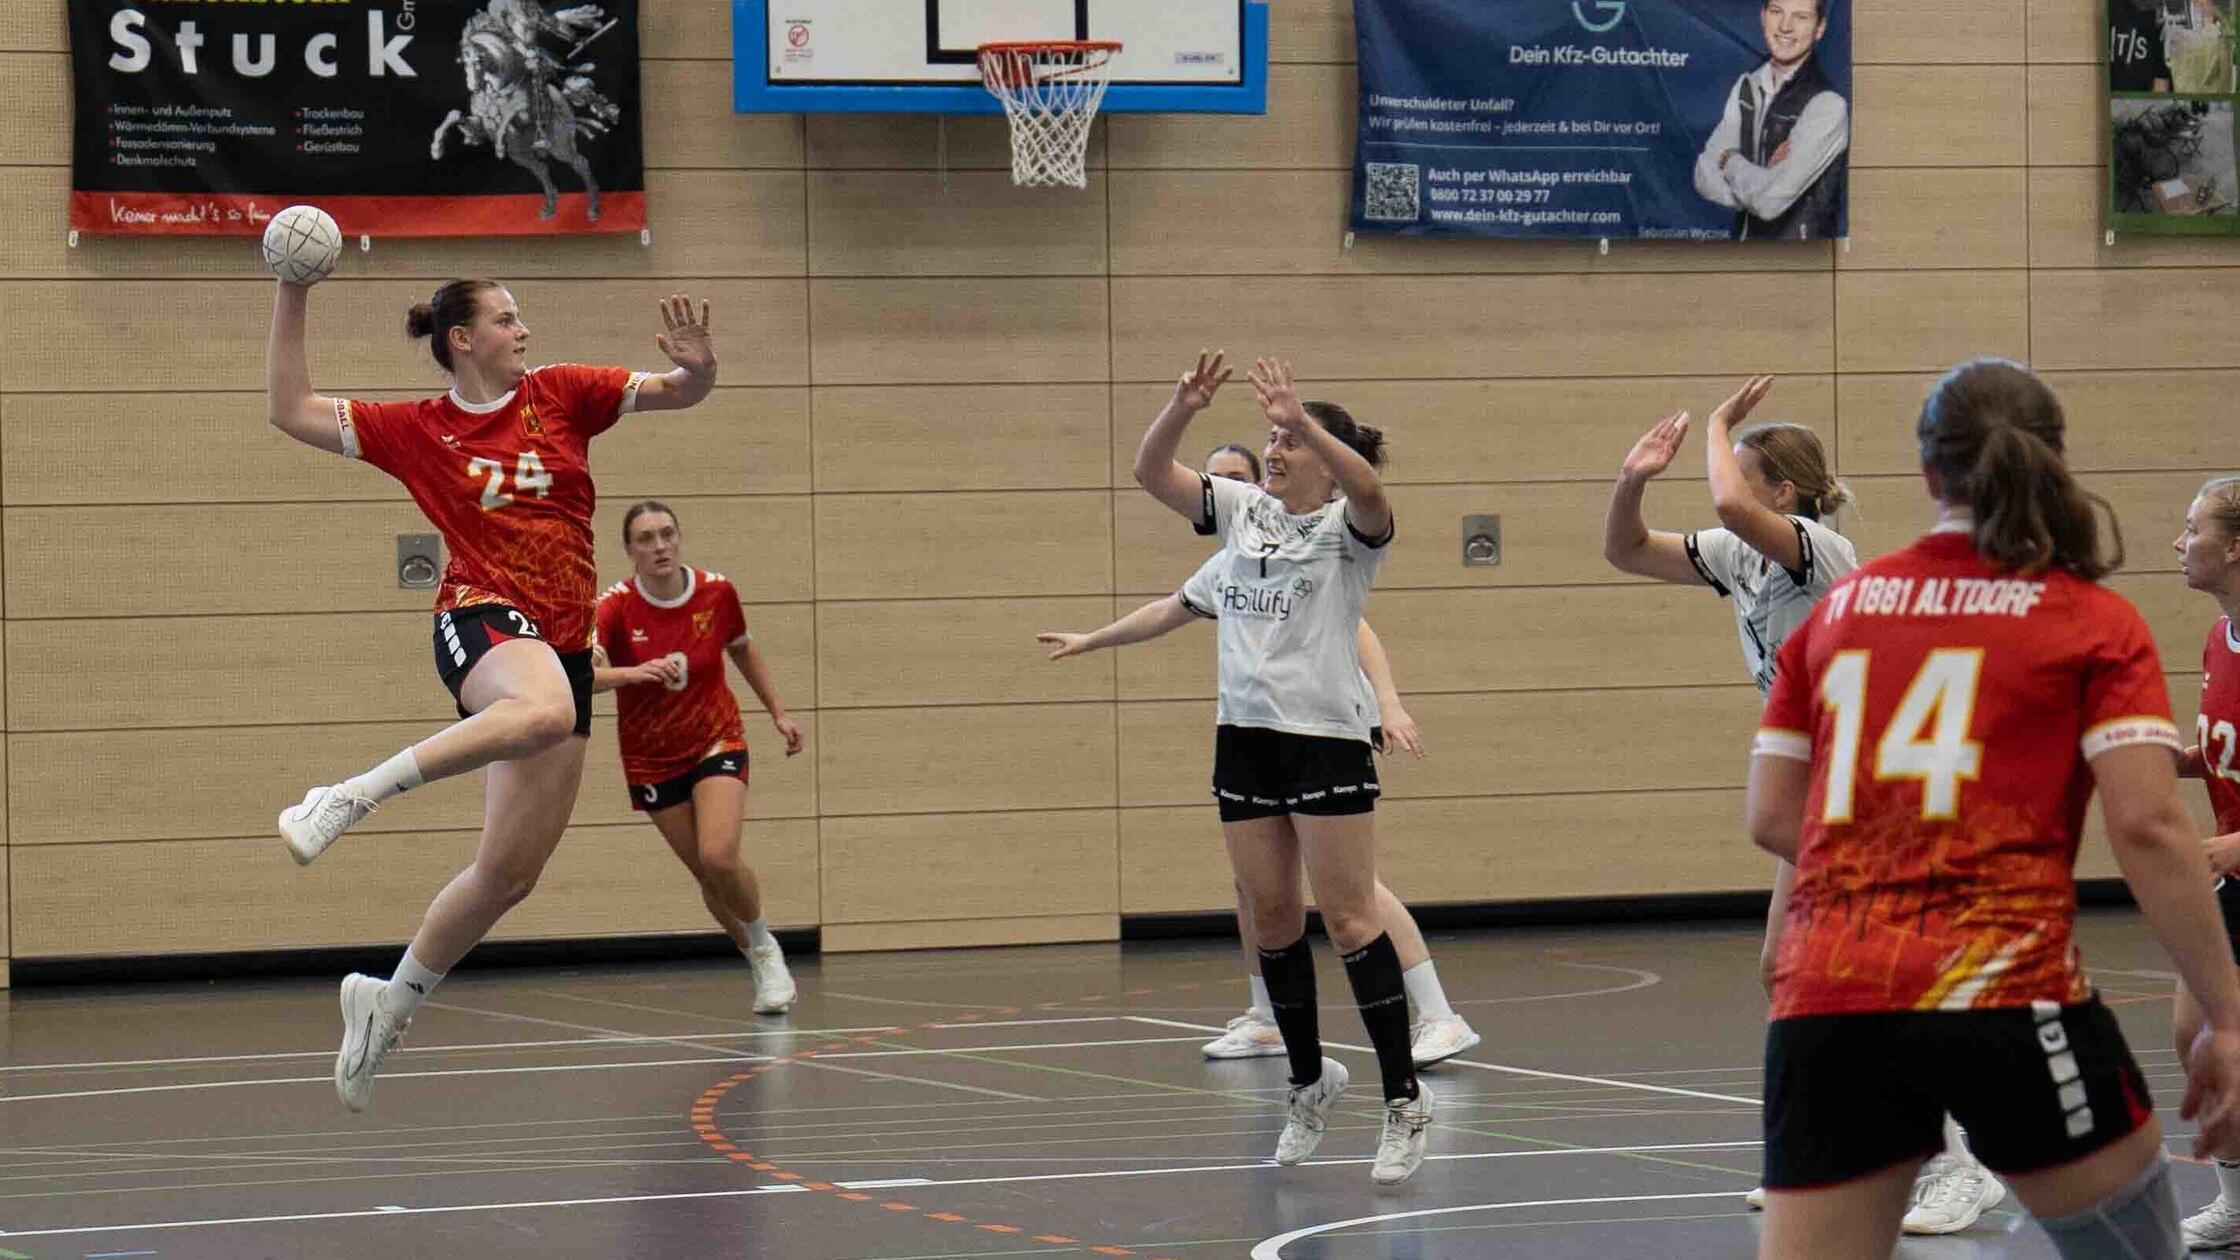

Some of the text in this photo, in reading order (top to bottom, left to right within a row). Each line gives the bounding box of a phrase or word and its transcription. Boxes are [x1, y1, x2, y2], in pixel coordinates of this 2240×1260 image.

[108, 9, 418, 77] Stuck
[1509, 45, 1689, 67] Dein Kfz-Gutachter
[152, 104, 172, 116] und
[175, 105, 233, 118] Außenputz
[302, 107, 364, 119] Trockenbau
[1470, 98, 1514, 111] Unfall?
[1369, 117, 1392, 128] Wir
[1430, 119, 1492, 132] kostenfrei
[1502, 120, 1555, 135] jederzeit
[1558, 121, 1568, 133] &
[1572, 121, 1592, 132] bei
[1594, 121, 1611, 132] Dir
[1614, 123, 1633, 133] vor
[116, 137, 216, 152] Fassadensanierung
[304, 140, 360, 152] Gerüstbau
[117, 153, 197, 167] Denkmalschutz
[1428, 168, 1632, 186] Auch per WhatsApp erreichbar
[1462, 189, 1477, 202] 72
[1479, 189, 1493, 202] 37
[1516, 190, 1532, 202] 29
[1533, 190, 1550, 203] 77
[1431, 208, 1621, 226] www.dein-kfz-gutachter.com
[467, 450, 553, 512] 24
[1259, 543, 1280, 578] 7
[1853, 576, 1914, 616] 1881
[1912, 577, 2047, 618] ALTDORF
[1822, 647, 1984, 825] 14
